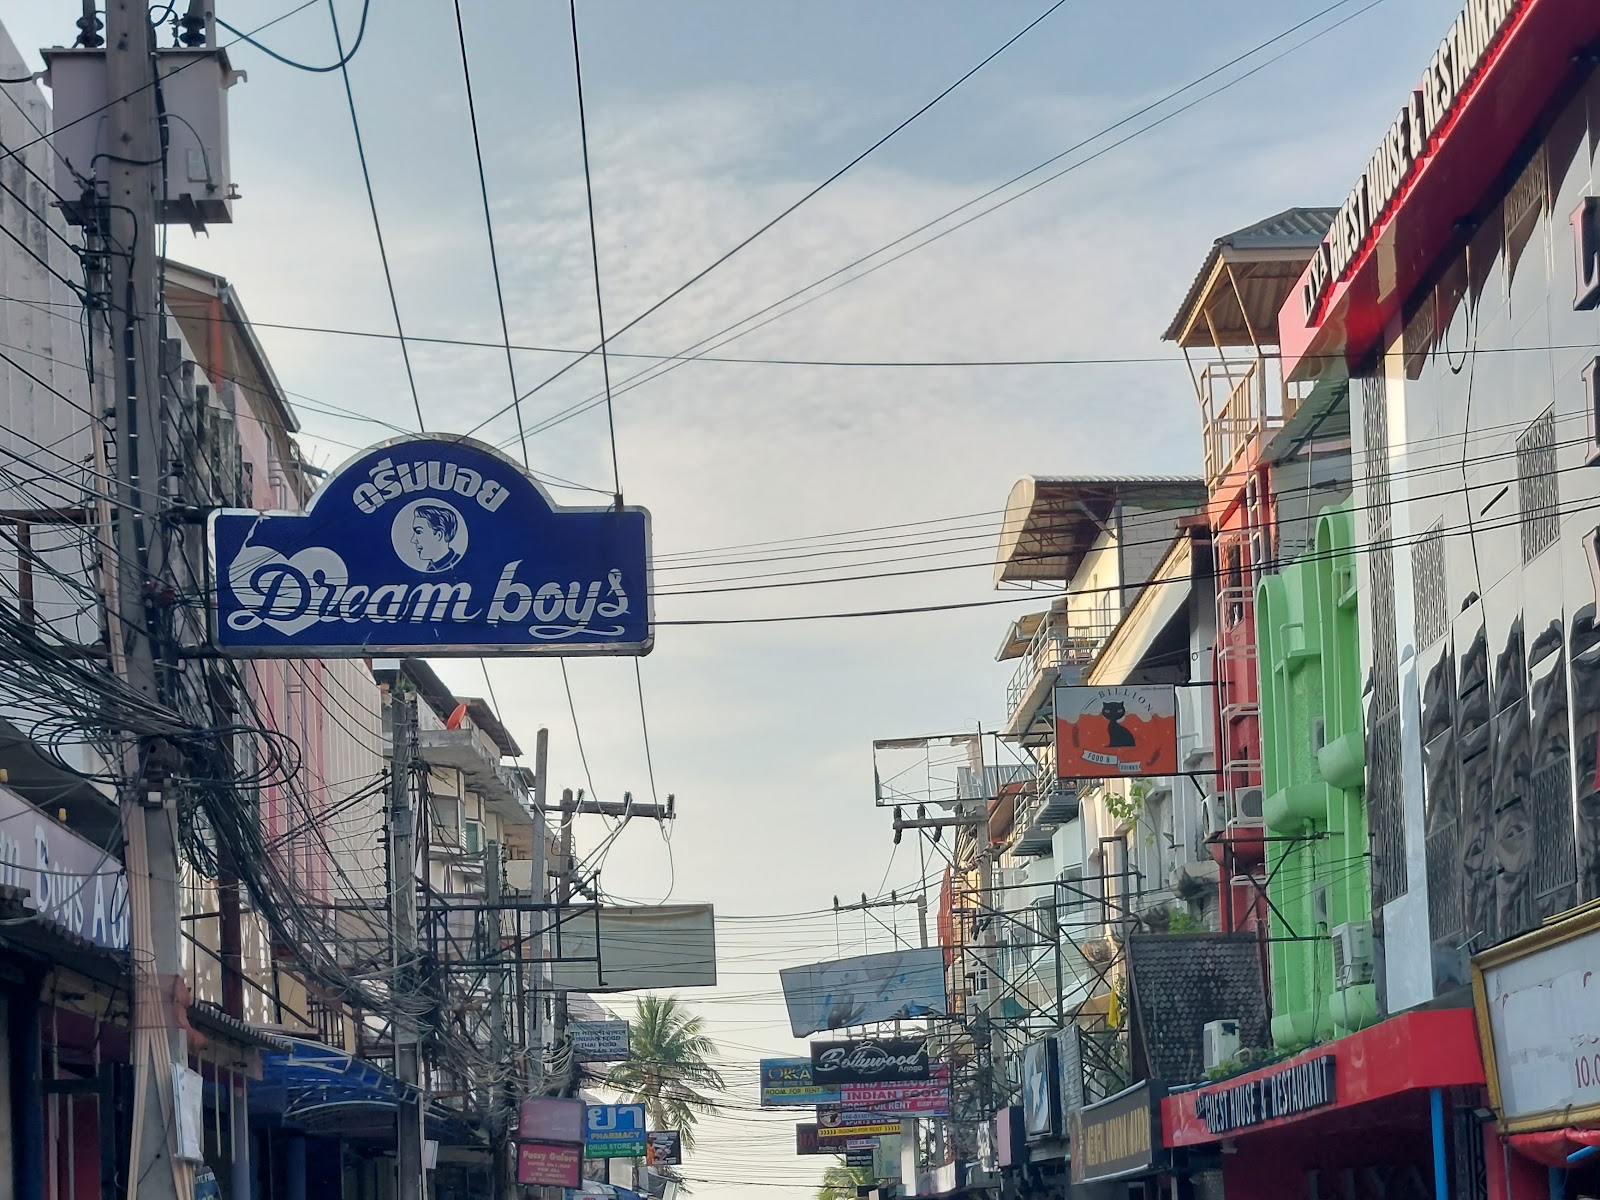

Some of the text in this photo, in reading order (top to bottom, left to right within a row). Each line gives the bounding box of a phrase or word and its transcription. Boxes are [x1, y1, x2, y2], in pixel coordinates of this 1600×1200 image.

[1328, 174, 1367, 282] GUEST
[1366, 107, 1408, 225] HOUSE
[1408, 90, 1422, 160] &
[227, 562, 483, 633] Dream
[1098, 687, 1154, 713] BILLION
[1087, 752, 1104, 763] FOOD
[34, 824, 84, 934] Boys
[815, 1045, 926, 1074] Bollywood
[846, 1090, 897, 1100] INDIAN
[888, 1101, 912, 1110] RENT
[1205, 1090, 1229, 1133] GUEST
[1229, 1082, 1256, 1128] HOUSE
[1260, 1078, 1267, 1121] &
[1271, 1056, 1329, 1118] RESTAURANT
[587, 1106, 643, 1130] ยา
[590, 1131, 641, 1140] PHARMACY
[608, 1142, 632, 1150] STORE
[522, 1150, 547, 1162] Pussy
[549, 1152, 578, 1163] Galore
